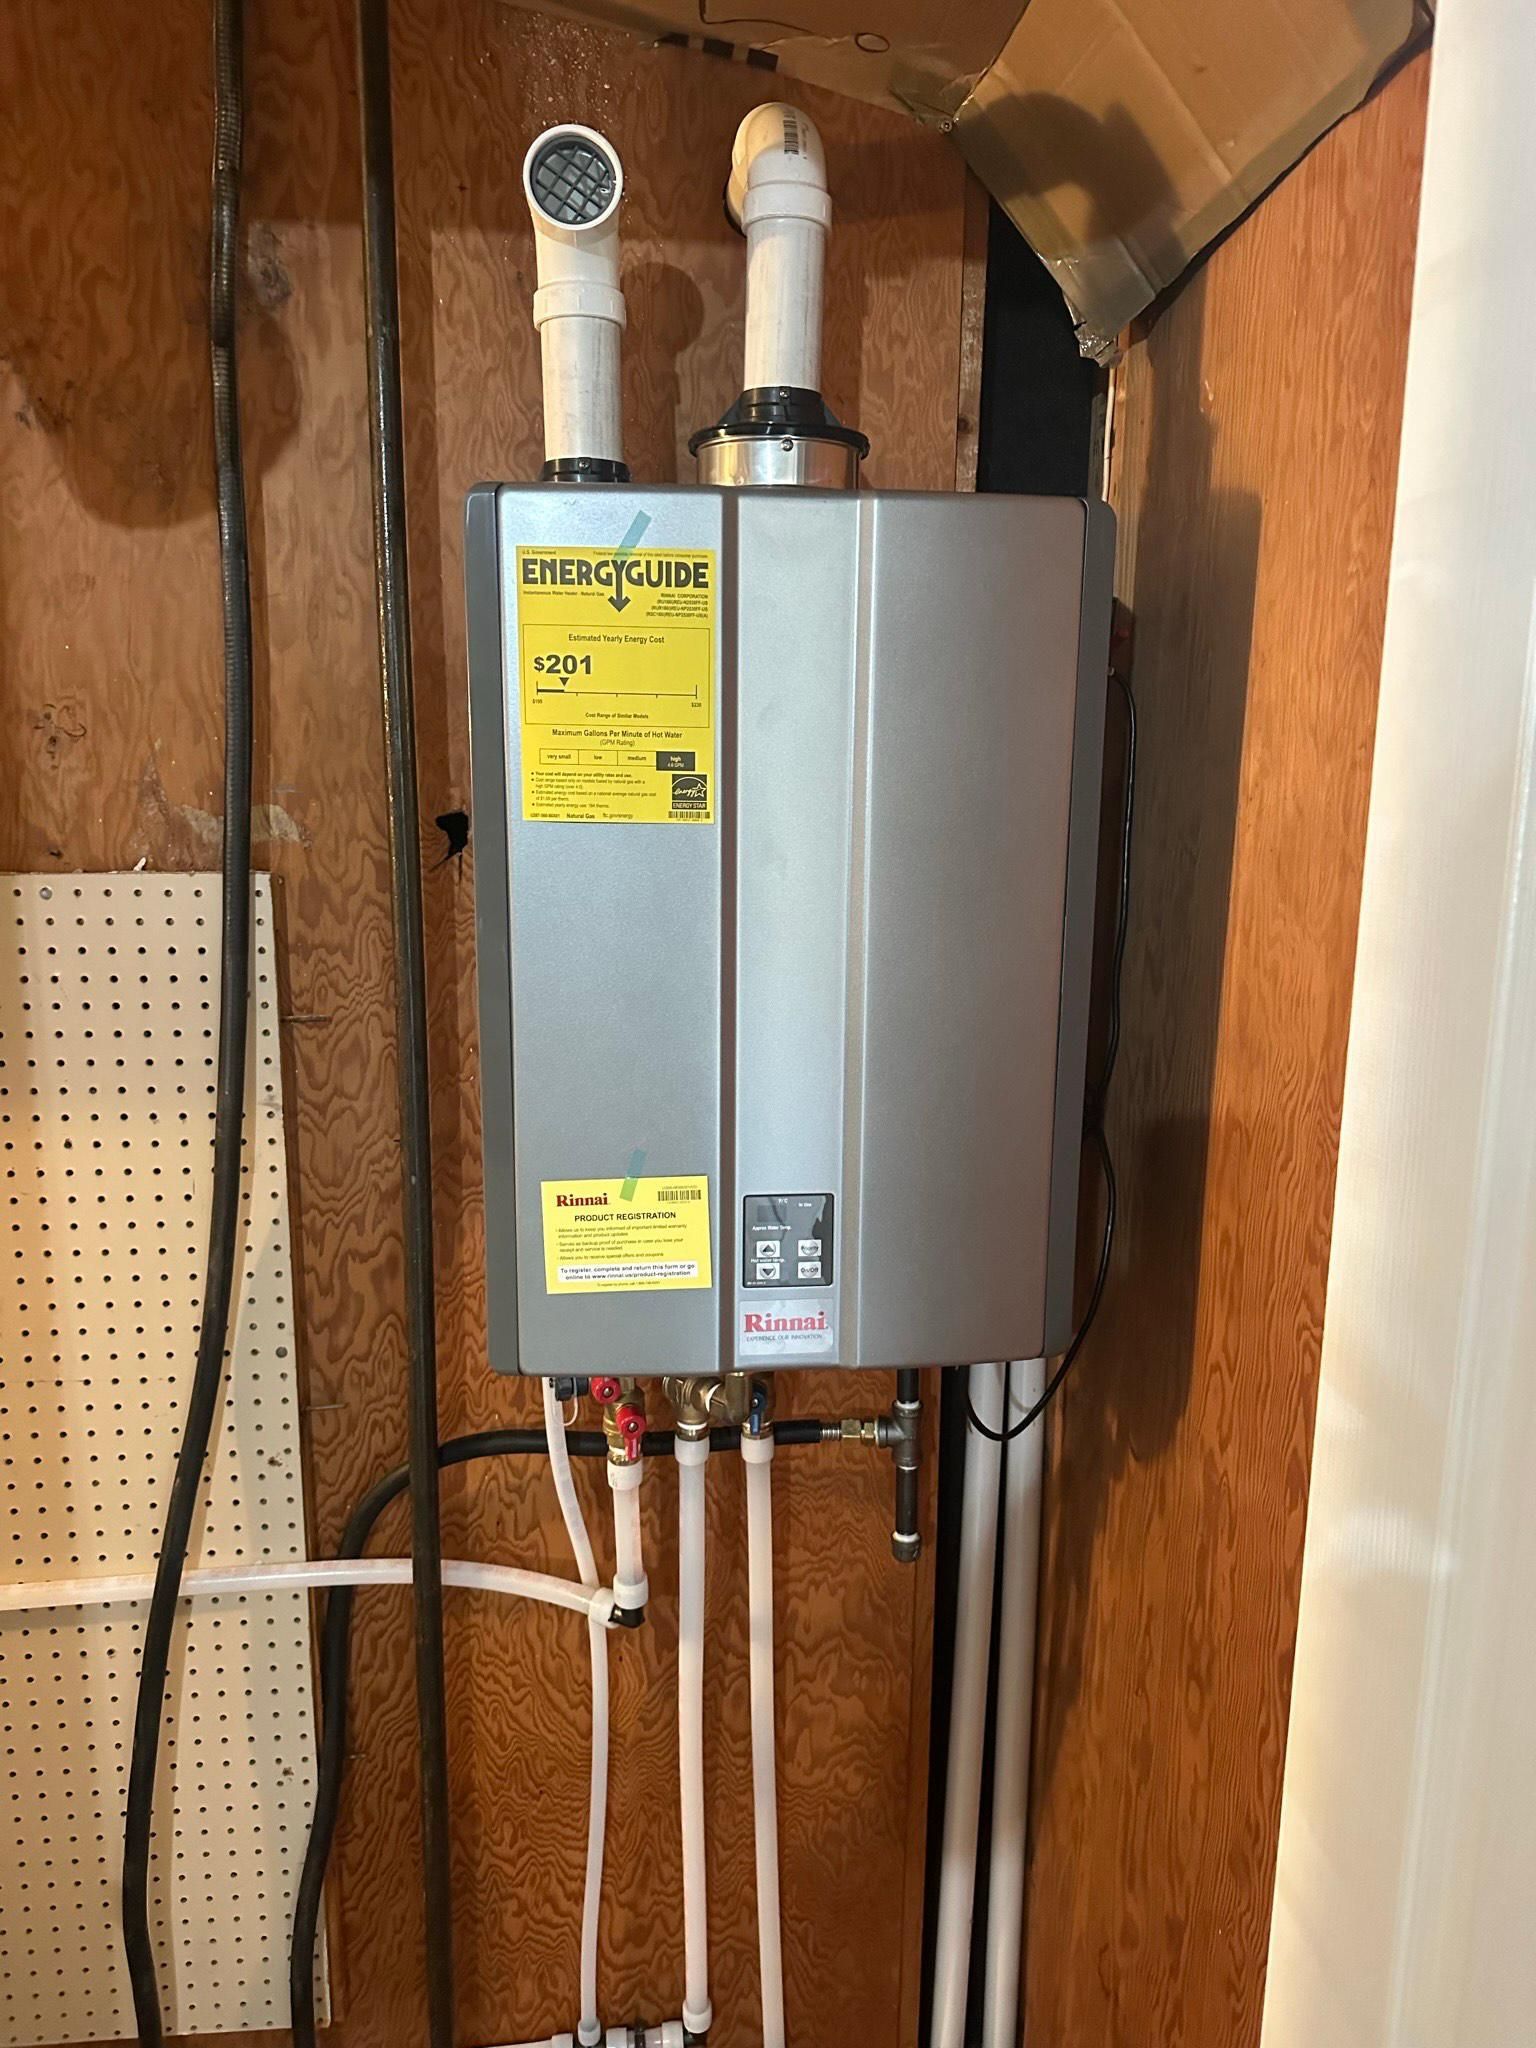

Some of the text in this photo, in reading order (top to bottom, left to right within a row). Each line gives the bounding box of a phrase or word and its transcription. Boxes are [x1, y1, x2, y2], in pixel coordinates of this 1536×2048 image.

[522, 558, 709, 589] ENERGYGUIDE
[568, 633, 665, 644] Estimated Yearly Energy Cost
[533, 654, 592, 675] $201
[552, 728, 583, 737] Maximum
[583, 729, 608, 738] Gallons
[609, 730, 620, 738] Per
[621, 730, 643, 738] Minute
[643, 730, 651, 738] of
[664, 731, 683, 739] Water
[599, 739, 635, 748] (GPM Rating)
[670, 755, 682, 763] high
[556, 1192, 609, 1207] Rinnai
[574, 1211, 676, 1223] PRODUCT REGISTRATION
[743, 1311, 825, 1333] Rinnai
